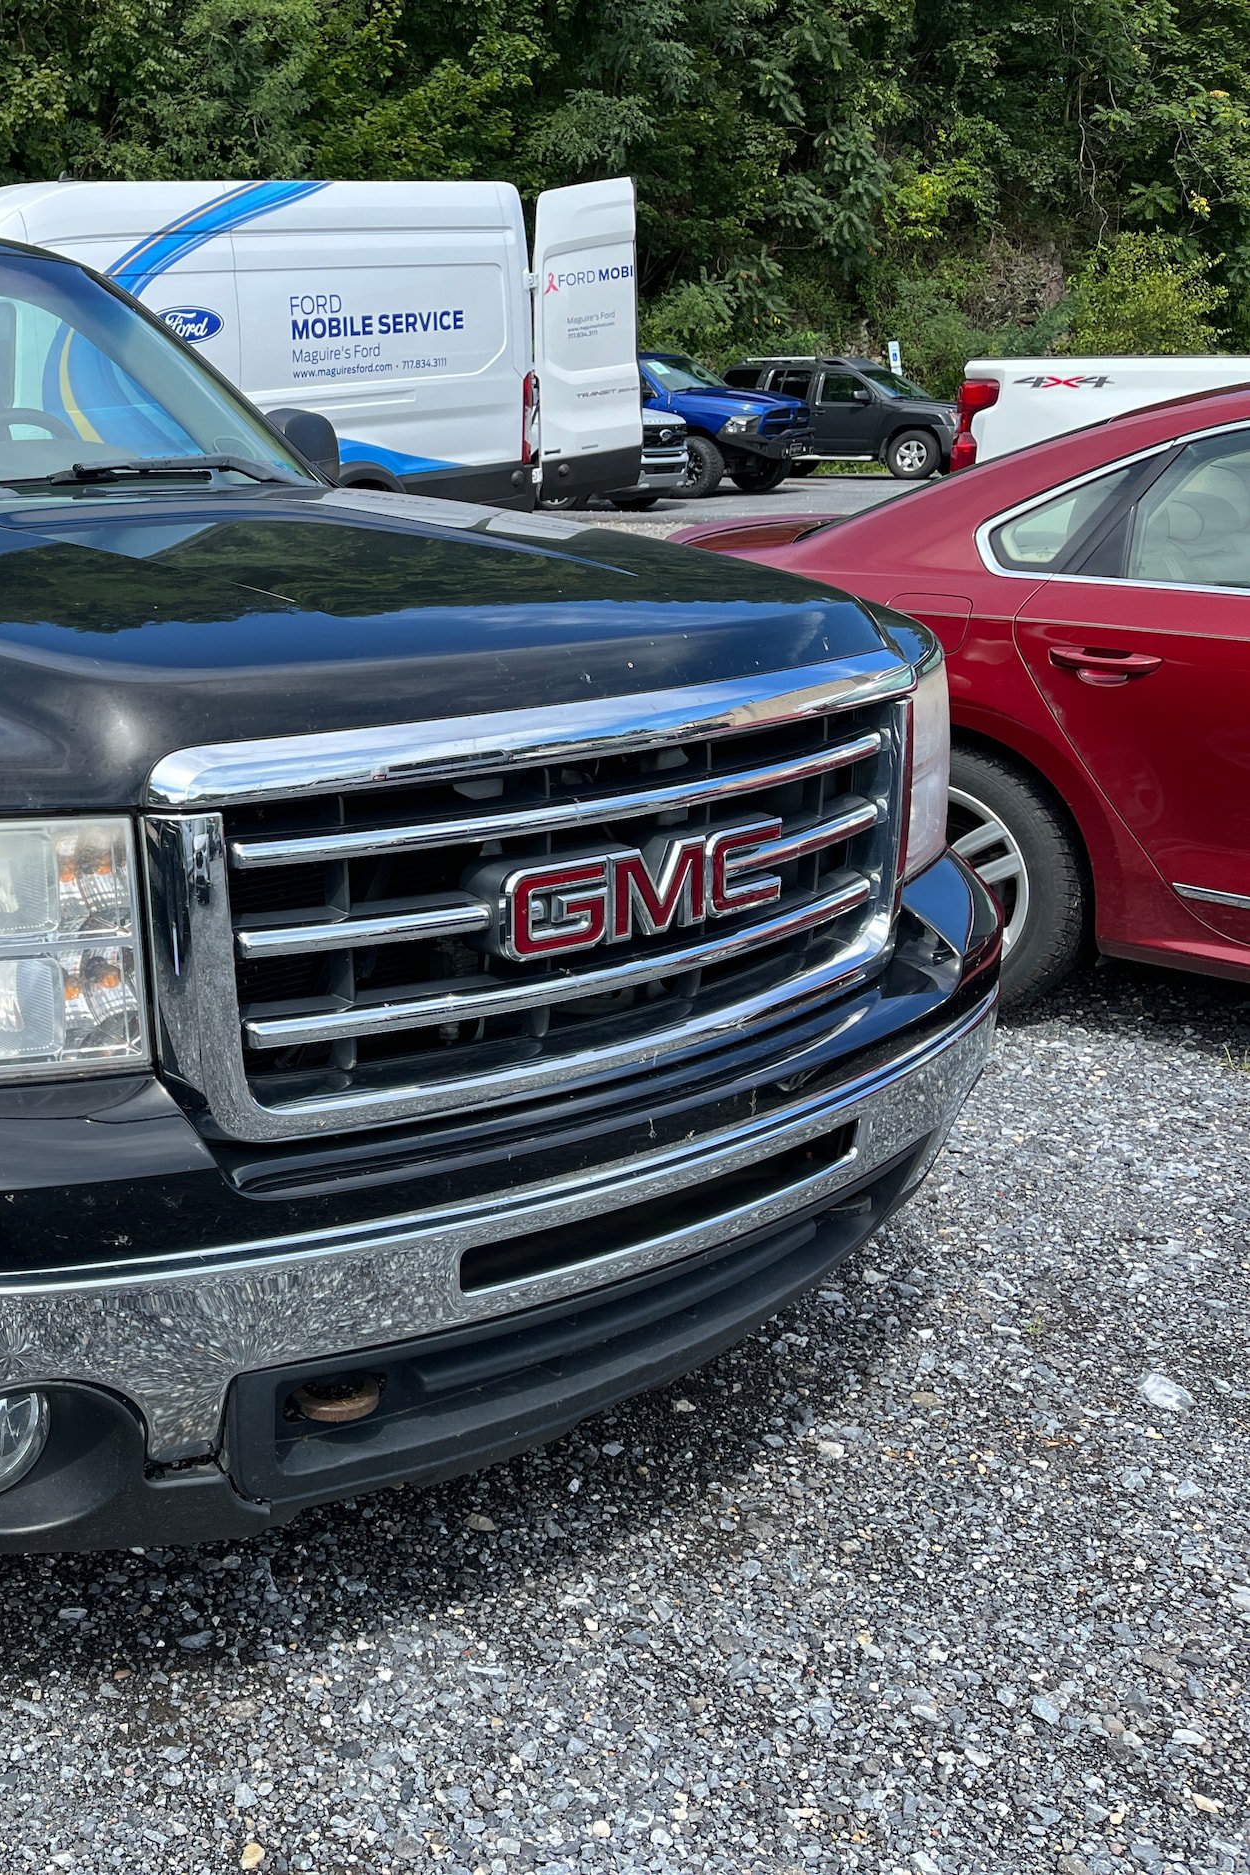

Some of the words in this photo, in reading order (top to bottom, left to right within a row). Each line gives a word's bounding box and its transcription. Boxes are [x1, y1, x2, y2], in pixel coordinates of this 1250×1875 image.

[557, 270, 595, 287] FORD
[598, 265, 633, 282] MOBI
[289, 294, 342, 316] FORD
[165, 312, 209, 337] Ford
[291, 315, 374, 340] MOBILE
[378, 310, 464, 335] SERVICE
[566, 313, 599, 325] Maguire's
[600, 310, 616, 320] Ford
[292, 346, 351, 365] Maguire's
[353, 342, 381, 358] Ford
[292, 363, 392, 378] www.maguiresford.com
[401, 357, 447, 370] 717.834.3111
[500, 817, 783, 962] GMC
